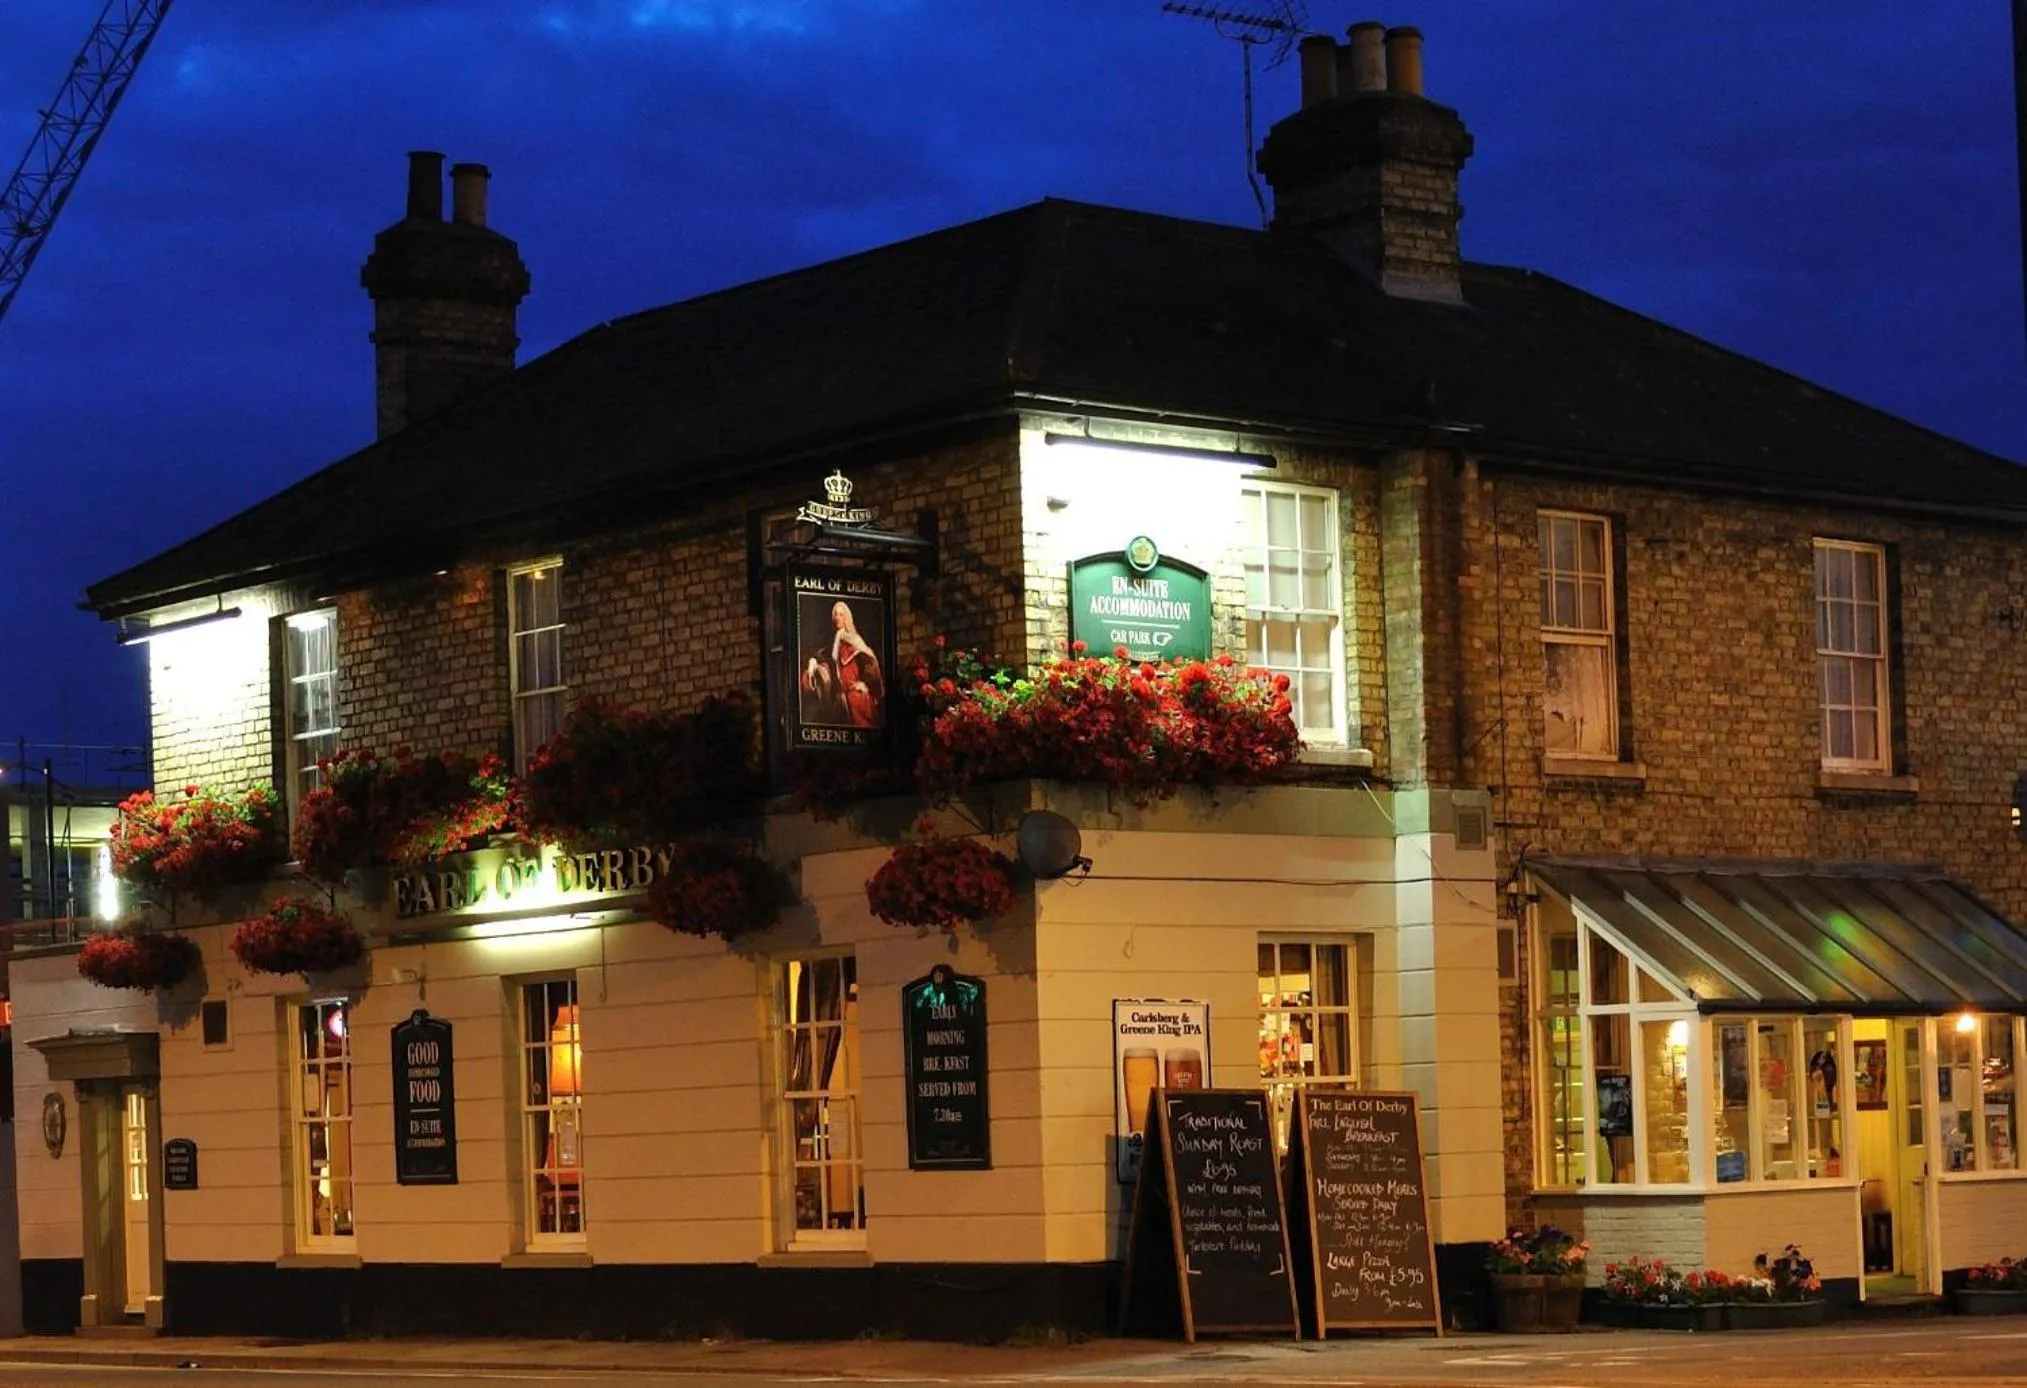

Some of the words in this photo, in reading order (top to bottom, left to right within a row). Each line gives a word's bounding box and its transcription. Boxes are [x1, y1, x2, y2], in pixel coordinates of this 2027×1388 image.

[794, 576, 825, 590] EARL
[828, 581, 842, 591] OF
[847, 582, 883, 594] DERBY
[1112, 575, 1168, 599] EN-SUITE
[1090, 595, 1191, 621] ACCOMMODATION
[1110, 629, 1127, 643] CAR
[1128, 630, 1151, 645] PARK
[801, 728, 850, 744] GREENE
[391, 866, 487, 917] EARL
[552, 843, 677, 893] DERBY
[1131, 1012, 1179, 1025] Carlsberg
[1181, 1013, 1190, 1023] &
[926, 1030, 965, 1046] MORNING
[1120, 1024, 1156, 1035] Greene
[1157, 1024, 1182, 1037] King
[1183, 1024, 1202, 1035] IPA
[407, 1042, 439, 1065] GOOD
[409, 1079, 441, 1103] FOOD
[918, 1082, 951, 1097] SERVED
[952, 1080, 977, 1096] FROM
[1310, 1098, 1332, 1111] The
[1334, 1100, 1357, 1112] Earl
[1359, 1100, 1374, 1110] Of
[1376, 1101, 1408, 1116] Derby
[1175, 1132, 1222, 1158] SUNDAY
[1230, 1132, 1264, 1157] ROAST
[1327, 1252, 1356, 1270] LARGE
[1360, 1267, 1386, 1282] FROM
